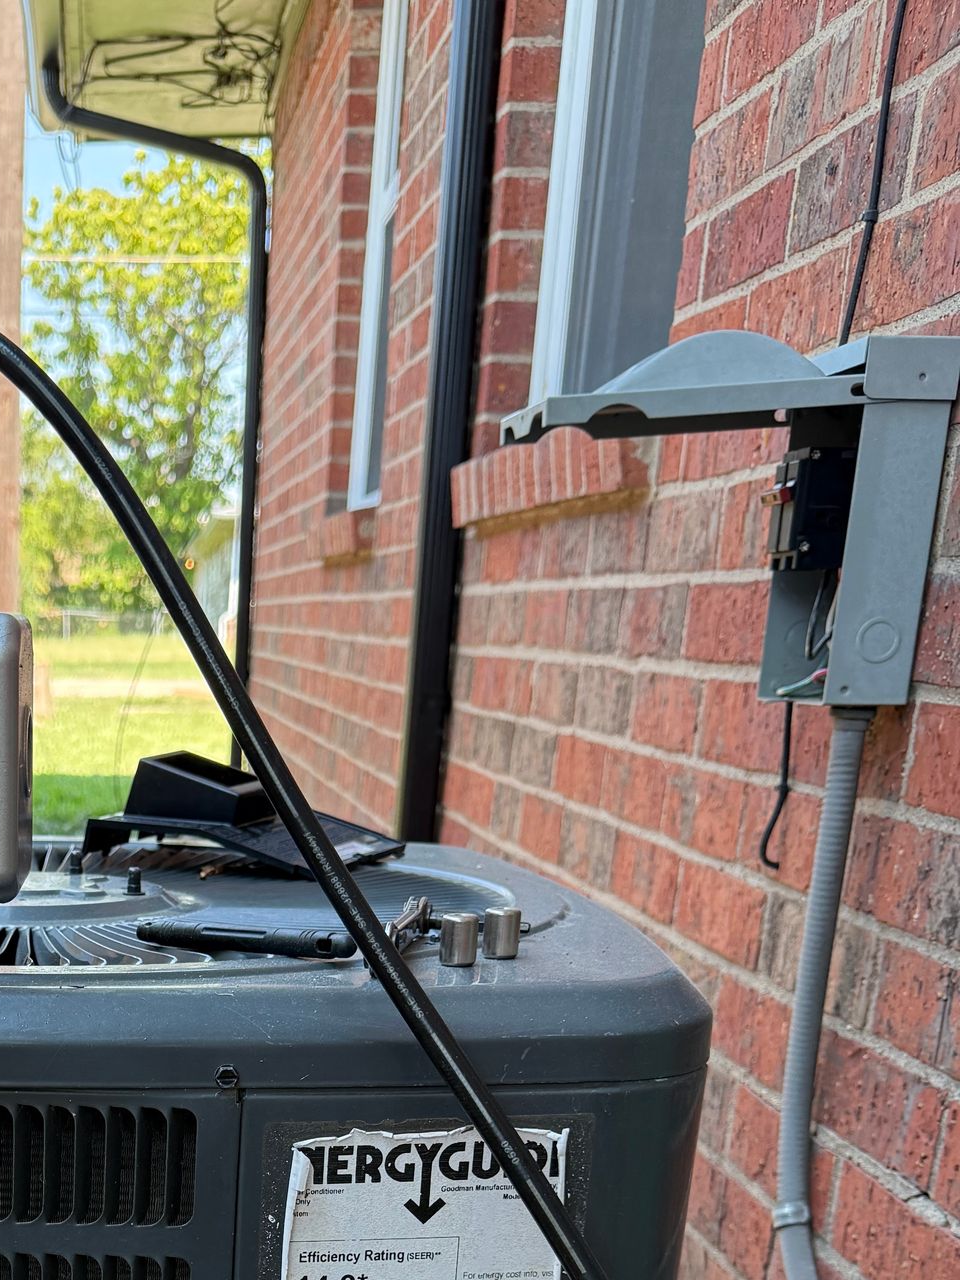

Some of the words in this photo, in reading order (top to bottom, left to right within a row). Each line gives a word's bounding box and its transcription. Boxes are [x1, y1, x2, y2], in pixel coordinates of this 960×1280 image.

[347, 906, 366, 929] SAE
[404, 996, 424, 1020] SAE
[501, 1140, 520, 1164] 0520
[296, 1198, 310, 1206] Only
[299, 1251, 360, 1265] Efficiency
[364, 1250, 405, 1263] Rating
